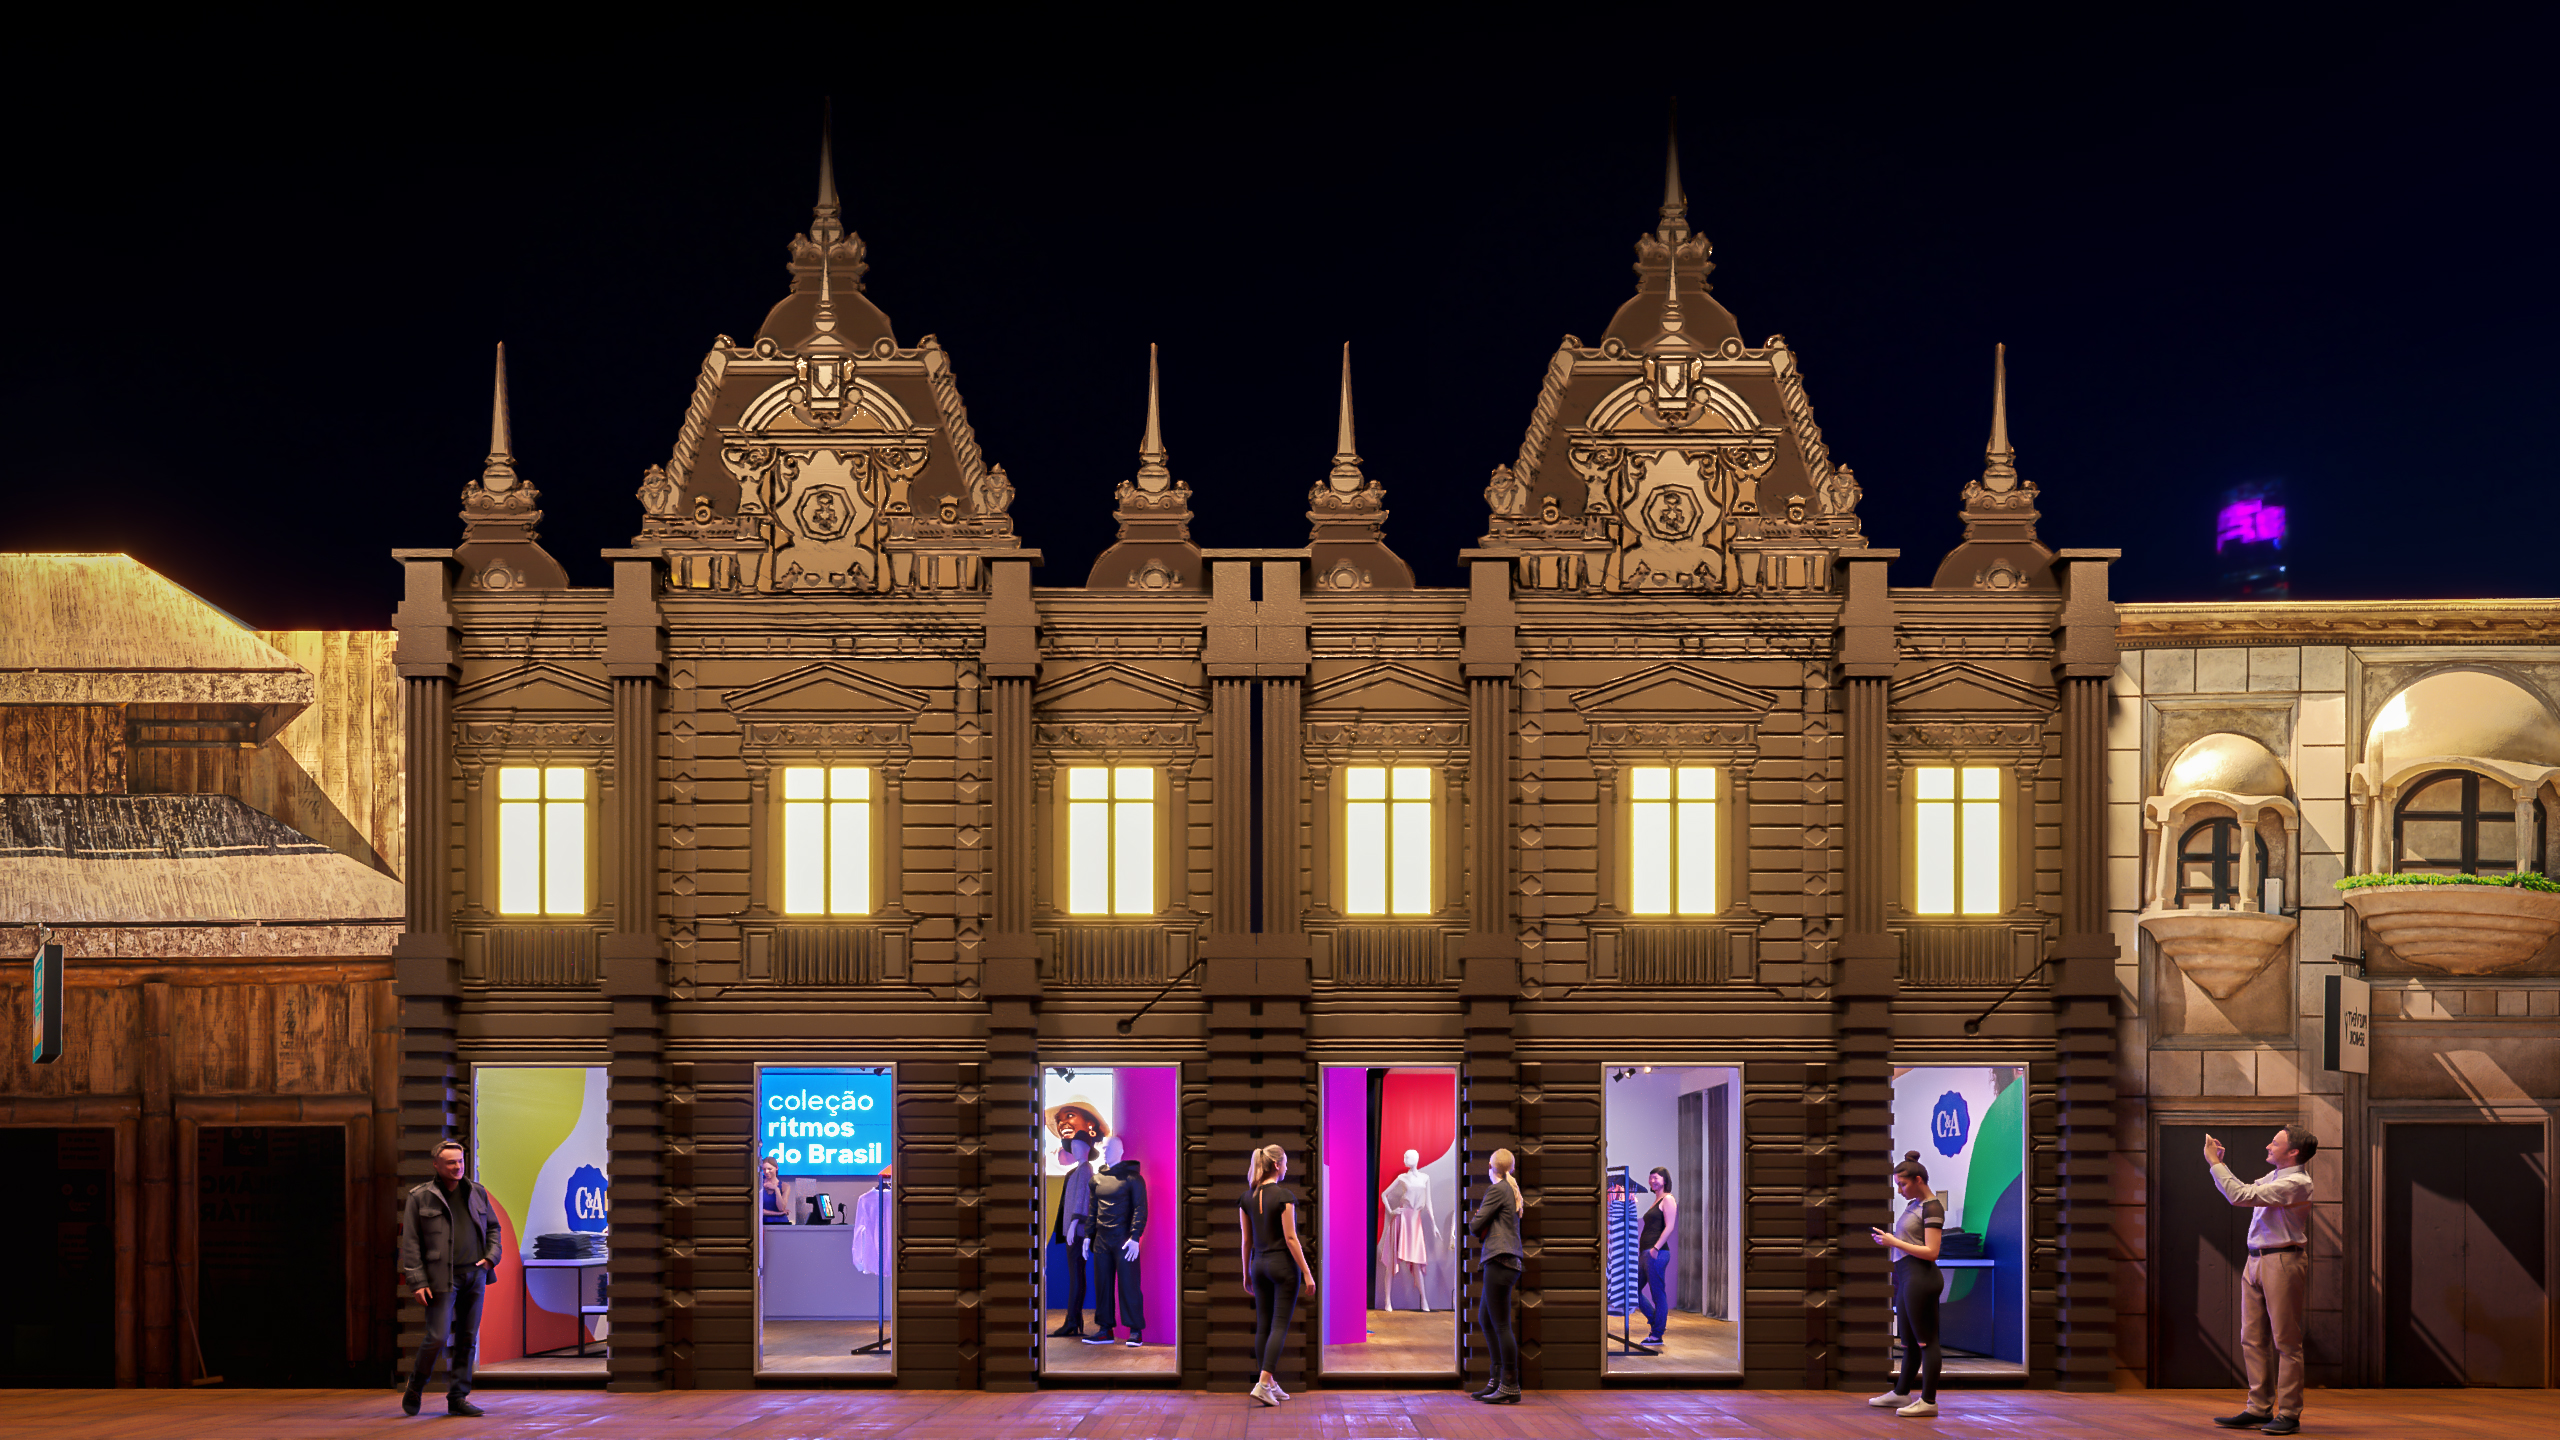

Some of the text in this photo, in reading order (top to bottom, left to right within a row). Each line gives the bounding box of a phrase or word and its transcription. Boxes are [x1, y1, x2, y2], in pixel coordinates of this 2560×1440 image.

[768, 1088, 874, 1117] coleção
[768, 1115, 856, 1138] ritmos
[1936, 1109, 1962, 1138] C&A
[768, 1142, 883, 1164] do Brasil
[574, 1186, 606, 1220] C&A
